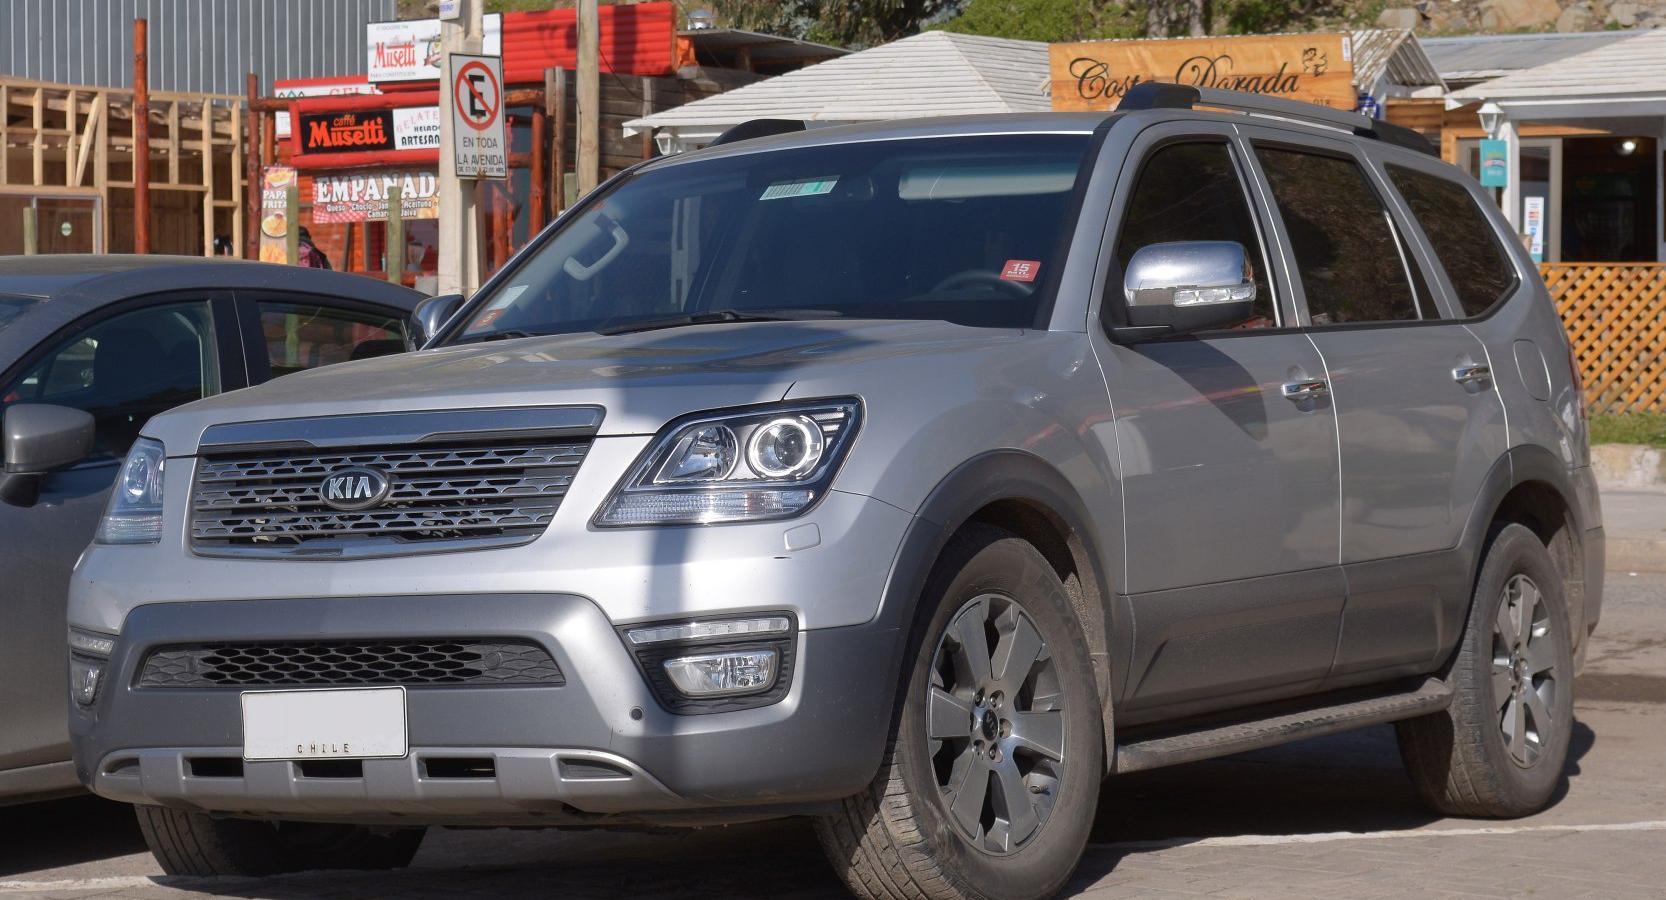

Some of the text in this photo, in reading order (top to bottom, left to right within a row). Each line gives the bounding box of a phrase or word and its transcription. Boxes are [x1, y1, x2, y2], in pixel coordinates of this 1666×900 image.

[373, 35, 416, 68] Musetti
[1069, 57, 1141, 99] Cost
[308, 117, 387, 148] Musetti
[462, 137, 498, 149] EN TODA
[457, 154, 504, 166] LA AVENIDA
[1010, 263, 1031, 272] 15
[328, 476, 372, 500] KIA
[297, 743, 350, 754] CHILE
